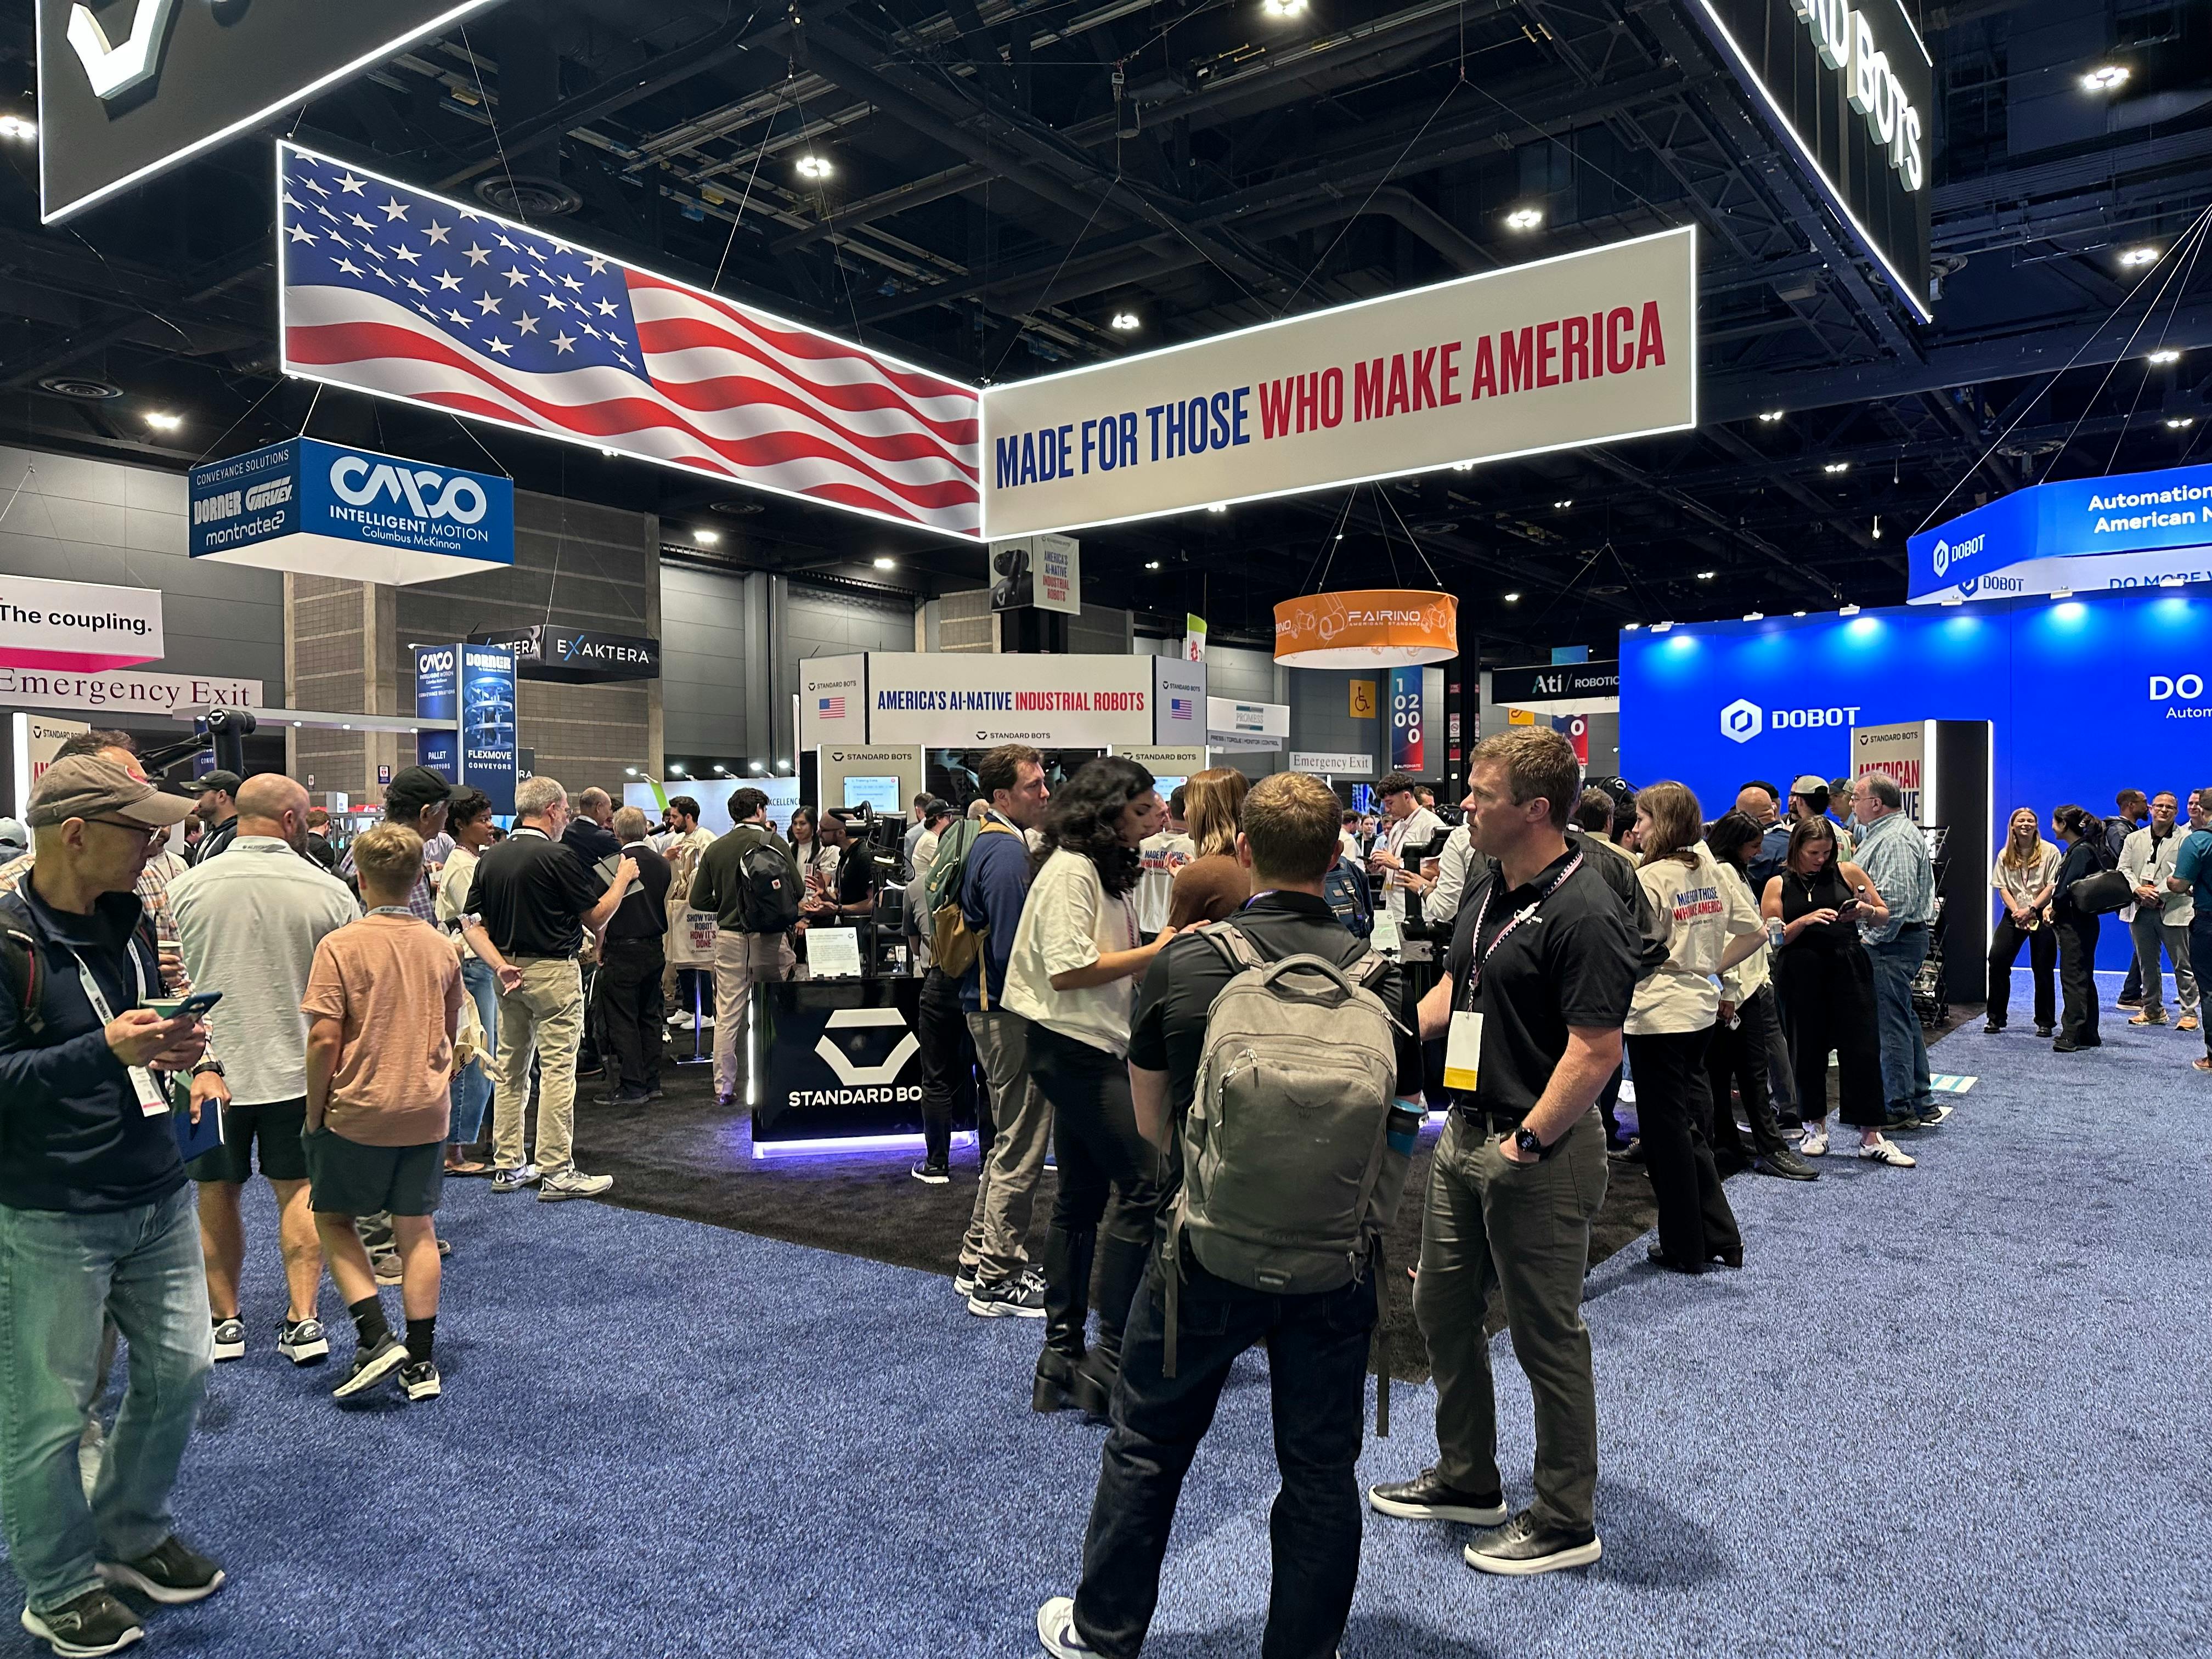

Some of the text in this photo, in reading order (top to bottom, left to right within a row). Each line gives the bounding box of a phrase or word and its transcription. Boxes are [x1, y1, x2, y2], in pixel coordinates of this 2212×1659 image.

[1849, 9, 1922, 191] BOTS
[997, 301, 1666, 489] MADE FOR THOSE WHO MAKE AMERICA
[196, 449, 289, 486] CONVEYANCE SOLUTIONS
[330, 456, 487, 524] CMCO
[2088, 485, 2212, 511] Automation
[194, 476, 292, 525] DORNER GARVEY
[206, 510, 285, 546] montratec
[330, 505, 488, 543] INTELLIGENT MOTION
[2094, 511, 2195, 533] American
[362, 526, 461, 550] Columbus McKinnon
[1951, 534, 1985, 562] DOBOT
[1045, 550, 1068, 566] AMERICA'S
[1045, 563, 1067, 578] AI-NATIVE
[1043, 574, 1069, 590] INDUSTRIAL
[1983, 575, 2024, 591] DOBOT
[2110, 577, 2137, 588] DO
[1047, 588, 1065, 602] ROBOTS
[0, 605, 153, 635] The coupling.
[1348, 610, 1420, 622] FAIRINO
[503, 639, 539, 654] TERA
[557, 635, 650, 664] EXAKTERA
[466, 653, 511, 670] DORNER
[0, 668, 250, 708] Emergency Exit
[1532, 674, 1620, 693] Ati ROBOTIC
[2149, 674, 2203, 700] DO
[878, 691, 1144, 711] AMERICA'S AI-NATIVE INDUSTRIAL ROBOTS
[1237, 713, 1263, 724] PROMESS
[1772, 707, 1860, 729] DOBOT
[43, 729, 70, 740] STANDARD
[1870, 733, 1901, 743] STANDARD
[428, 751, 446, 760] PALLET
[468, 750, 511, 760] FLEXMOVE
[1294, 754, 1368, 770] Emergency Exit
[469, 762, 511, 770] CONVEYORS
[769, 798, 800, 806] XCELLENC
[1144, 850, 1159, 859] MADE
[1171, 851, 1185, 860] OSE
[1141, 859, 1164, 868] WHO MA
[1698, 887, 1718, 900] THOSE
[1673, 907, 1689, 921] WH
[1698, 900, 1723, 915] AMERICA
[690, 931, 703, 939] HOW
[696, 939, 712, 948] DONE
[789, 1086, 922, 1107] STANDARD BO
